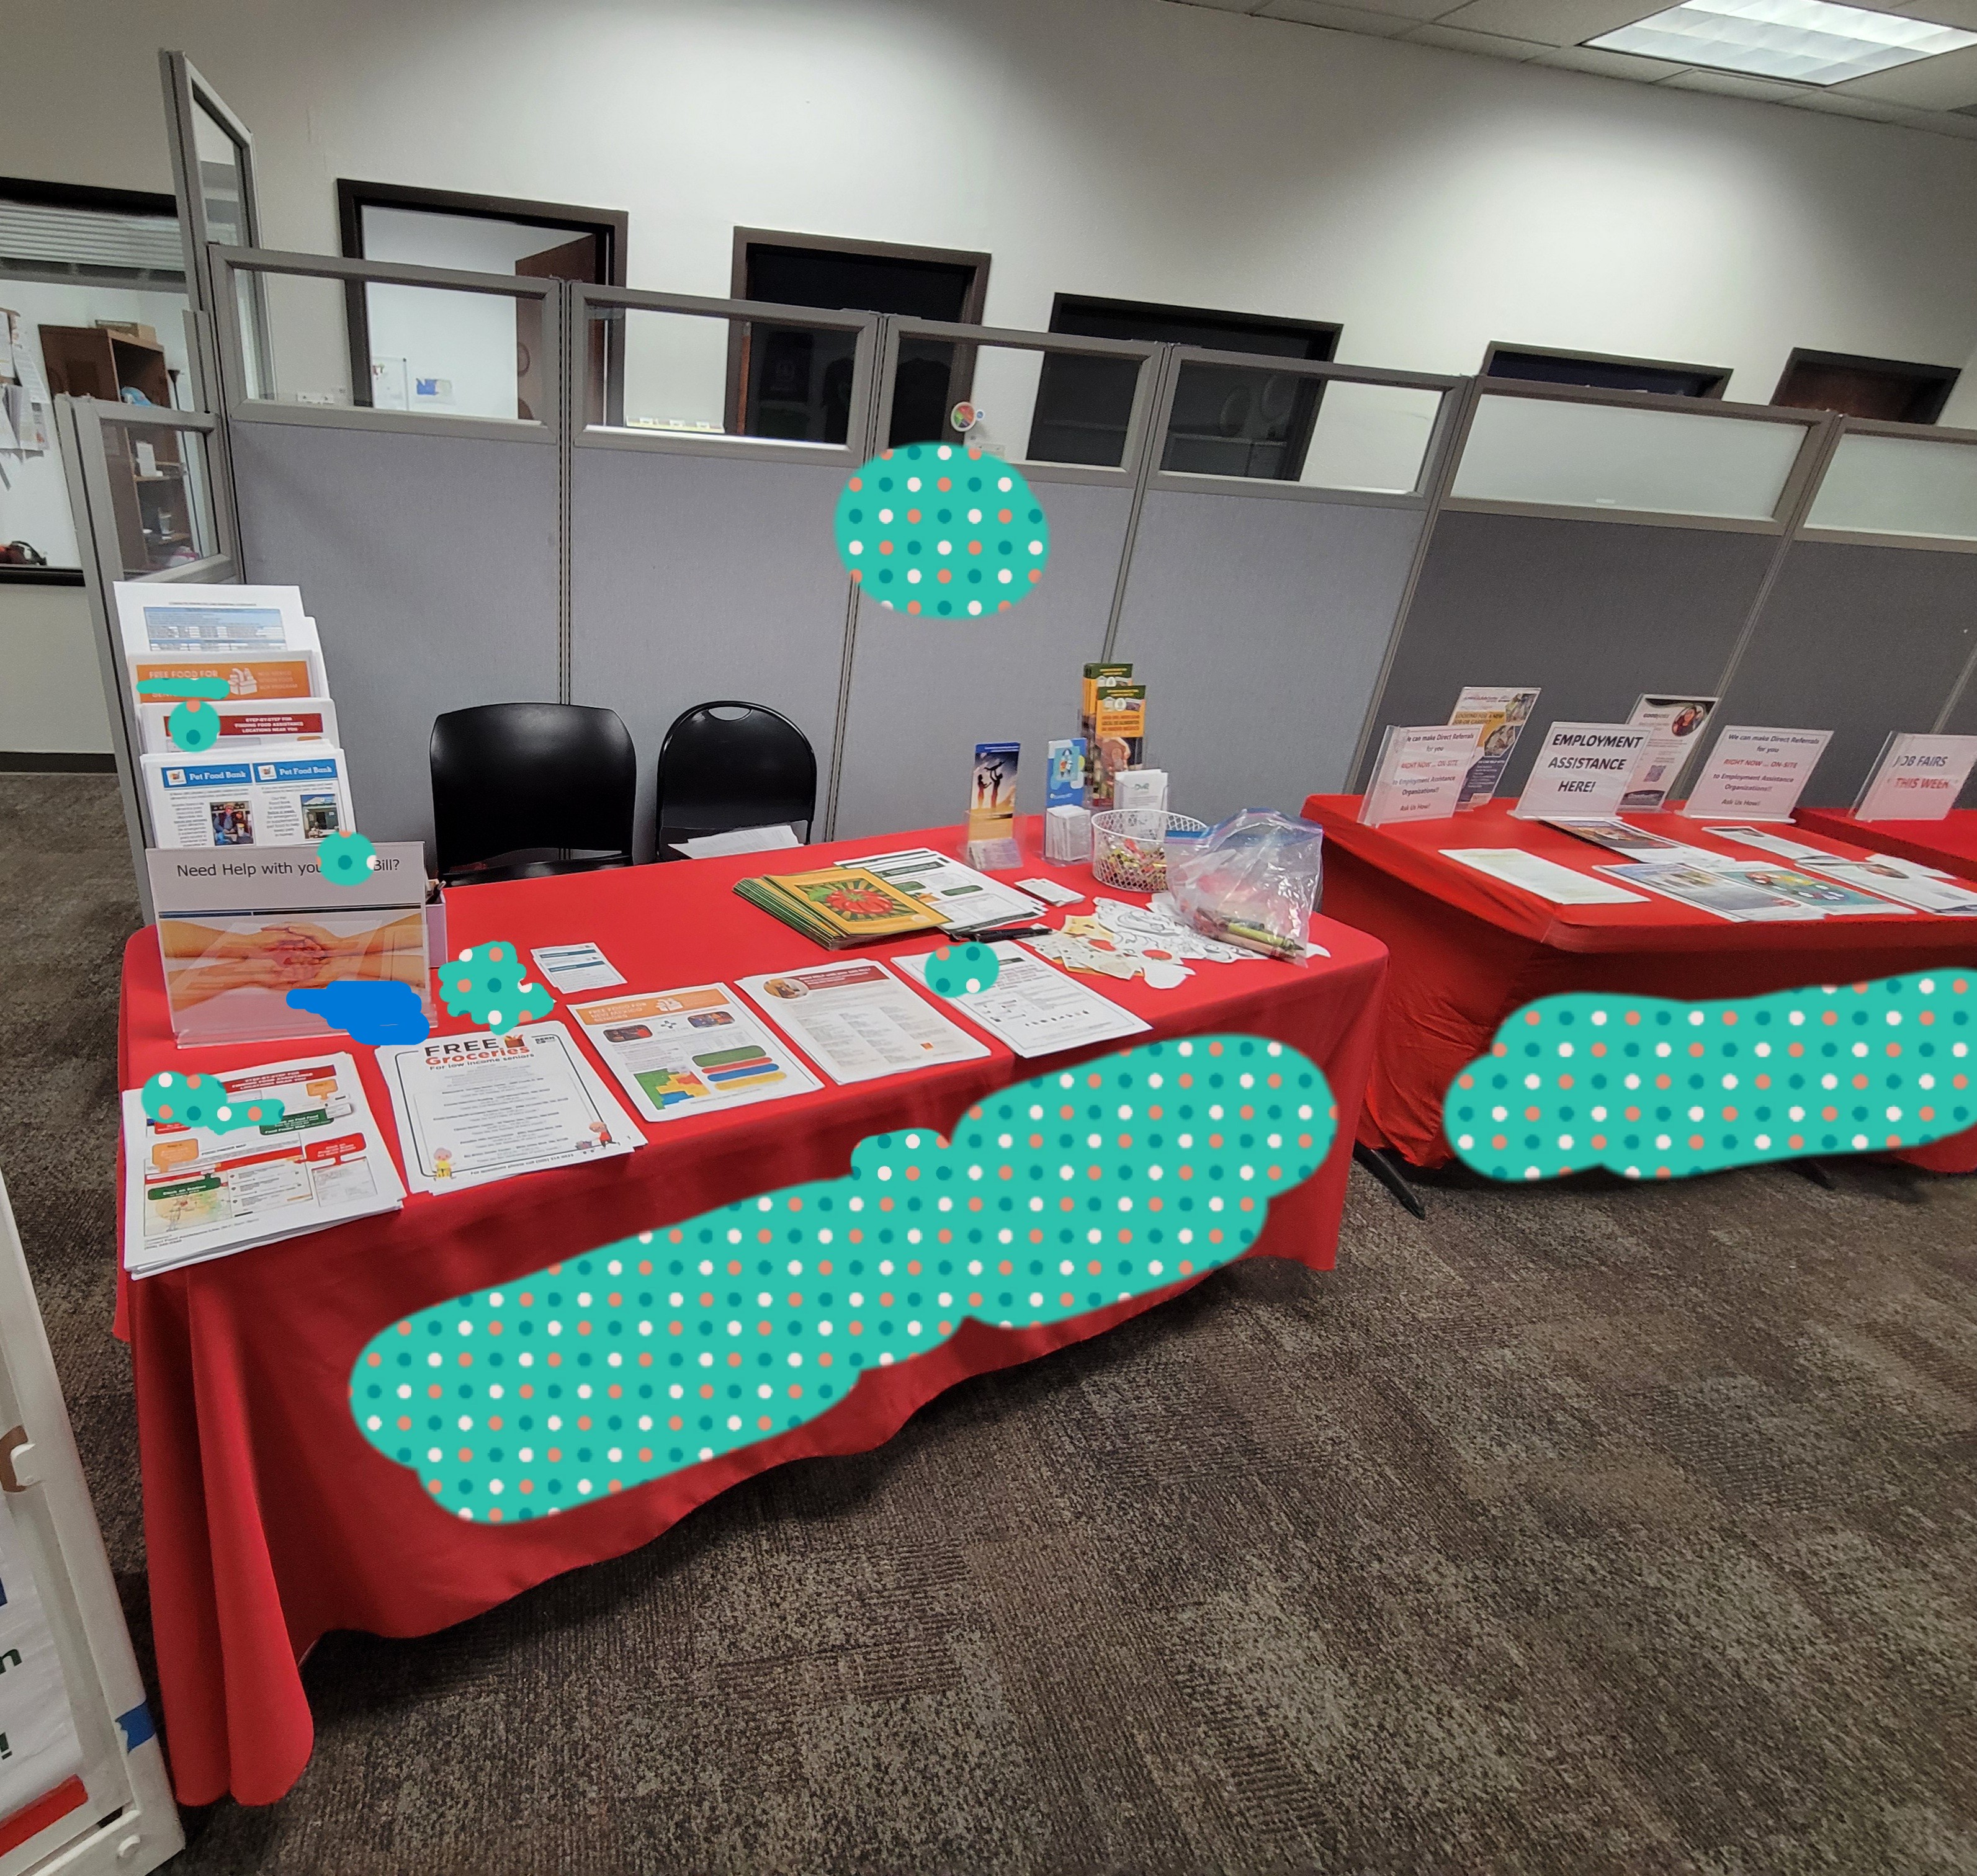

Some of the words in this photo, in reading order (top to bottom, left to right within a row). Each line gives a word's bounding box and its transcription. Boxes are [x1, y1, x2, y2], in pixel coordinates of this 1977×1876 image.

[1552, 734, 1644, 748] EMPLOYMENT
[1548, 757, 1627, 770] ASSISTANCE
[1893, 756, 1916, 767] JOB
[1917, 756, 1948, 767] FAIRS
[226, 770, 246, 779] Bank
[292, 767, 312, 775] Food
[313, 766, 332, 774] Bank
[1399, 777, 1430, 785] Employment
[1721, 773, 1761, 782] Employment
[1896, 777, 1920, 788] THIS
[1921, 778, 1950, 789] WEEK
[1558, 780, 1597, 793] HERE!
[177, 864, 217, 877] Need
[223, 862, 256, 878] Help
[261, 861, 293, 874] with
[298, 864, 321, 878] you
[424, 1038, 500, 1056] FREE
[426, 1046, 531, 1065] Groceries
[467, 1058, 501, 1066] income
[503, 1053, 535, 1062] seniors
